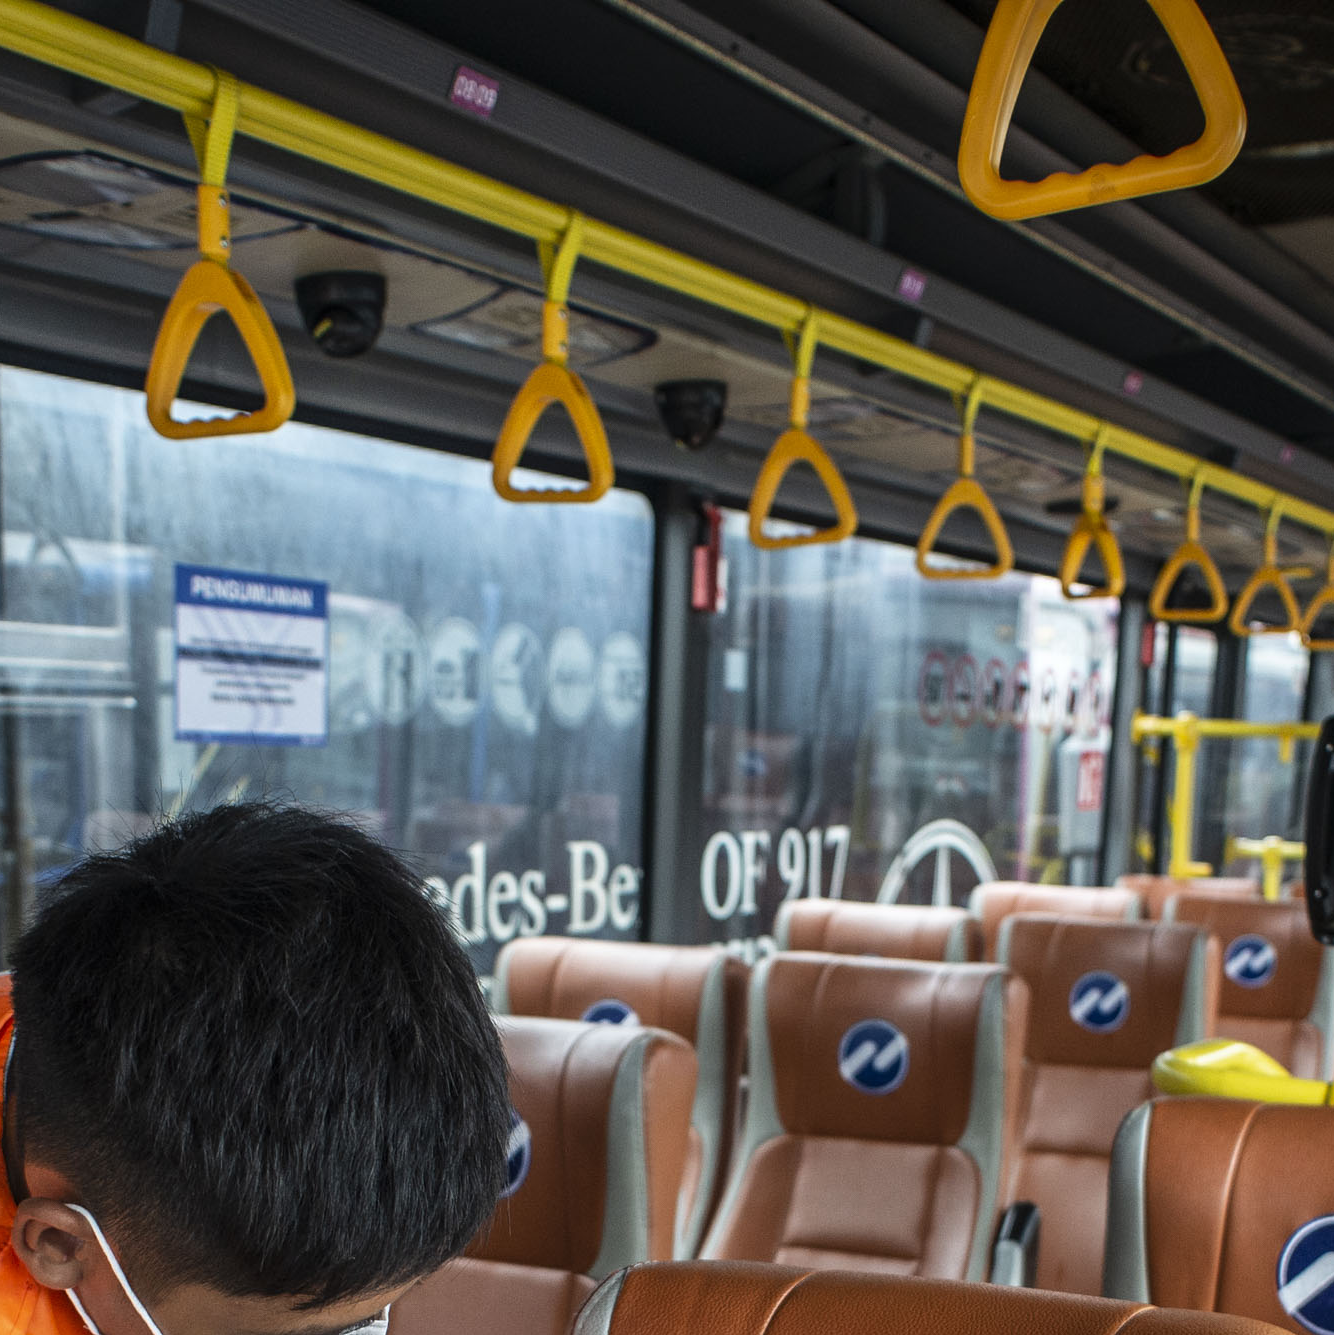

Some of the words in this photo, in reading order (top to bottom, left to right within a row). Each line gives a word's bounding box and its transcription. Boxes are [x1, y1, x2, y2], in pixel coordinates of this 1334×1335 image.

[190, 575, 314, 608] PENGUMUMAN
[701, 830, 771, 920] OF
[778, 824, 851, 900] 917
